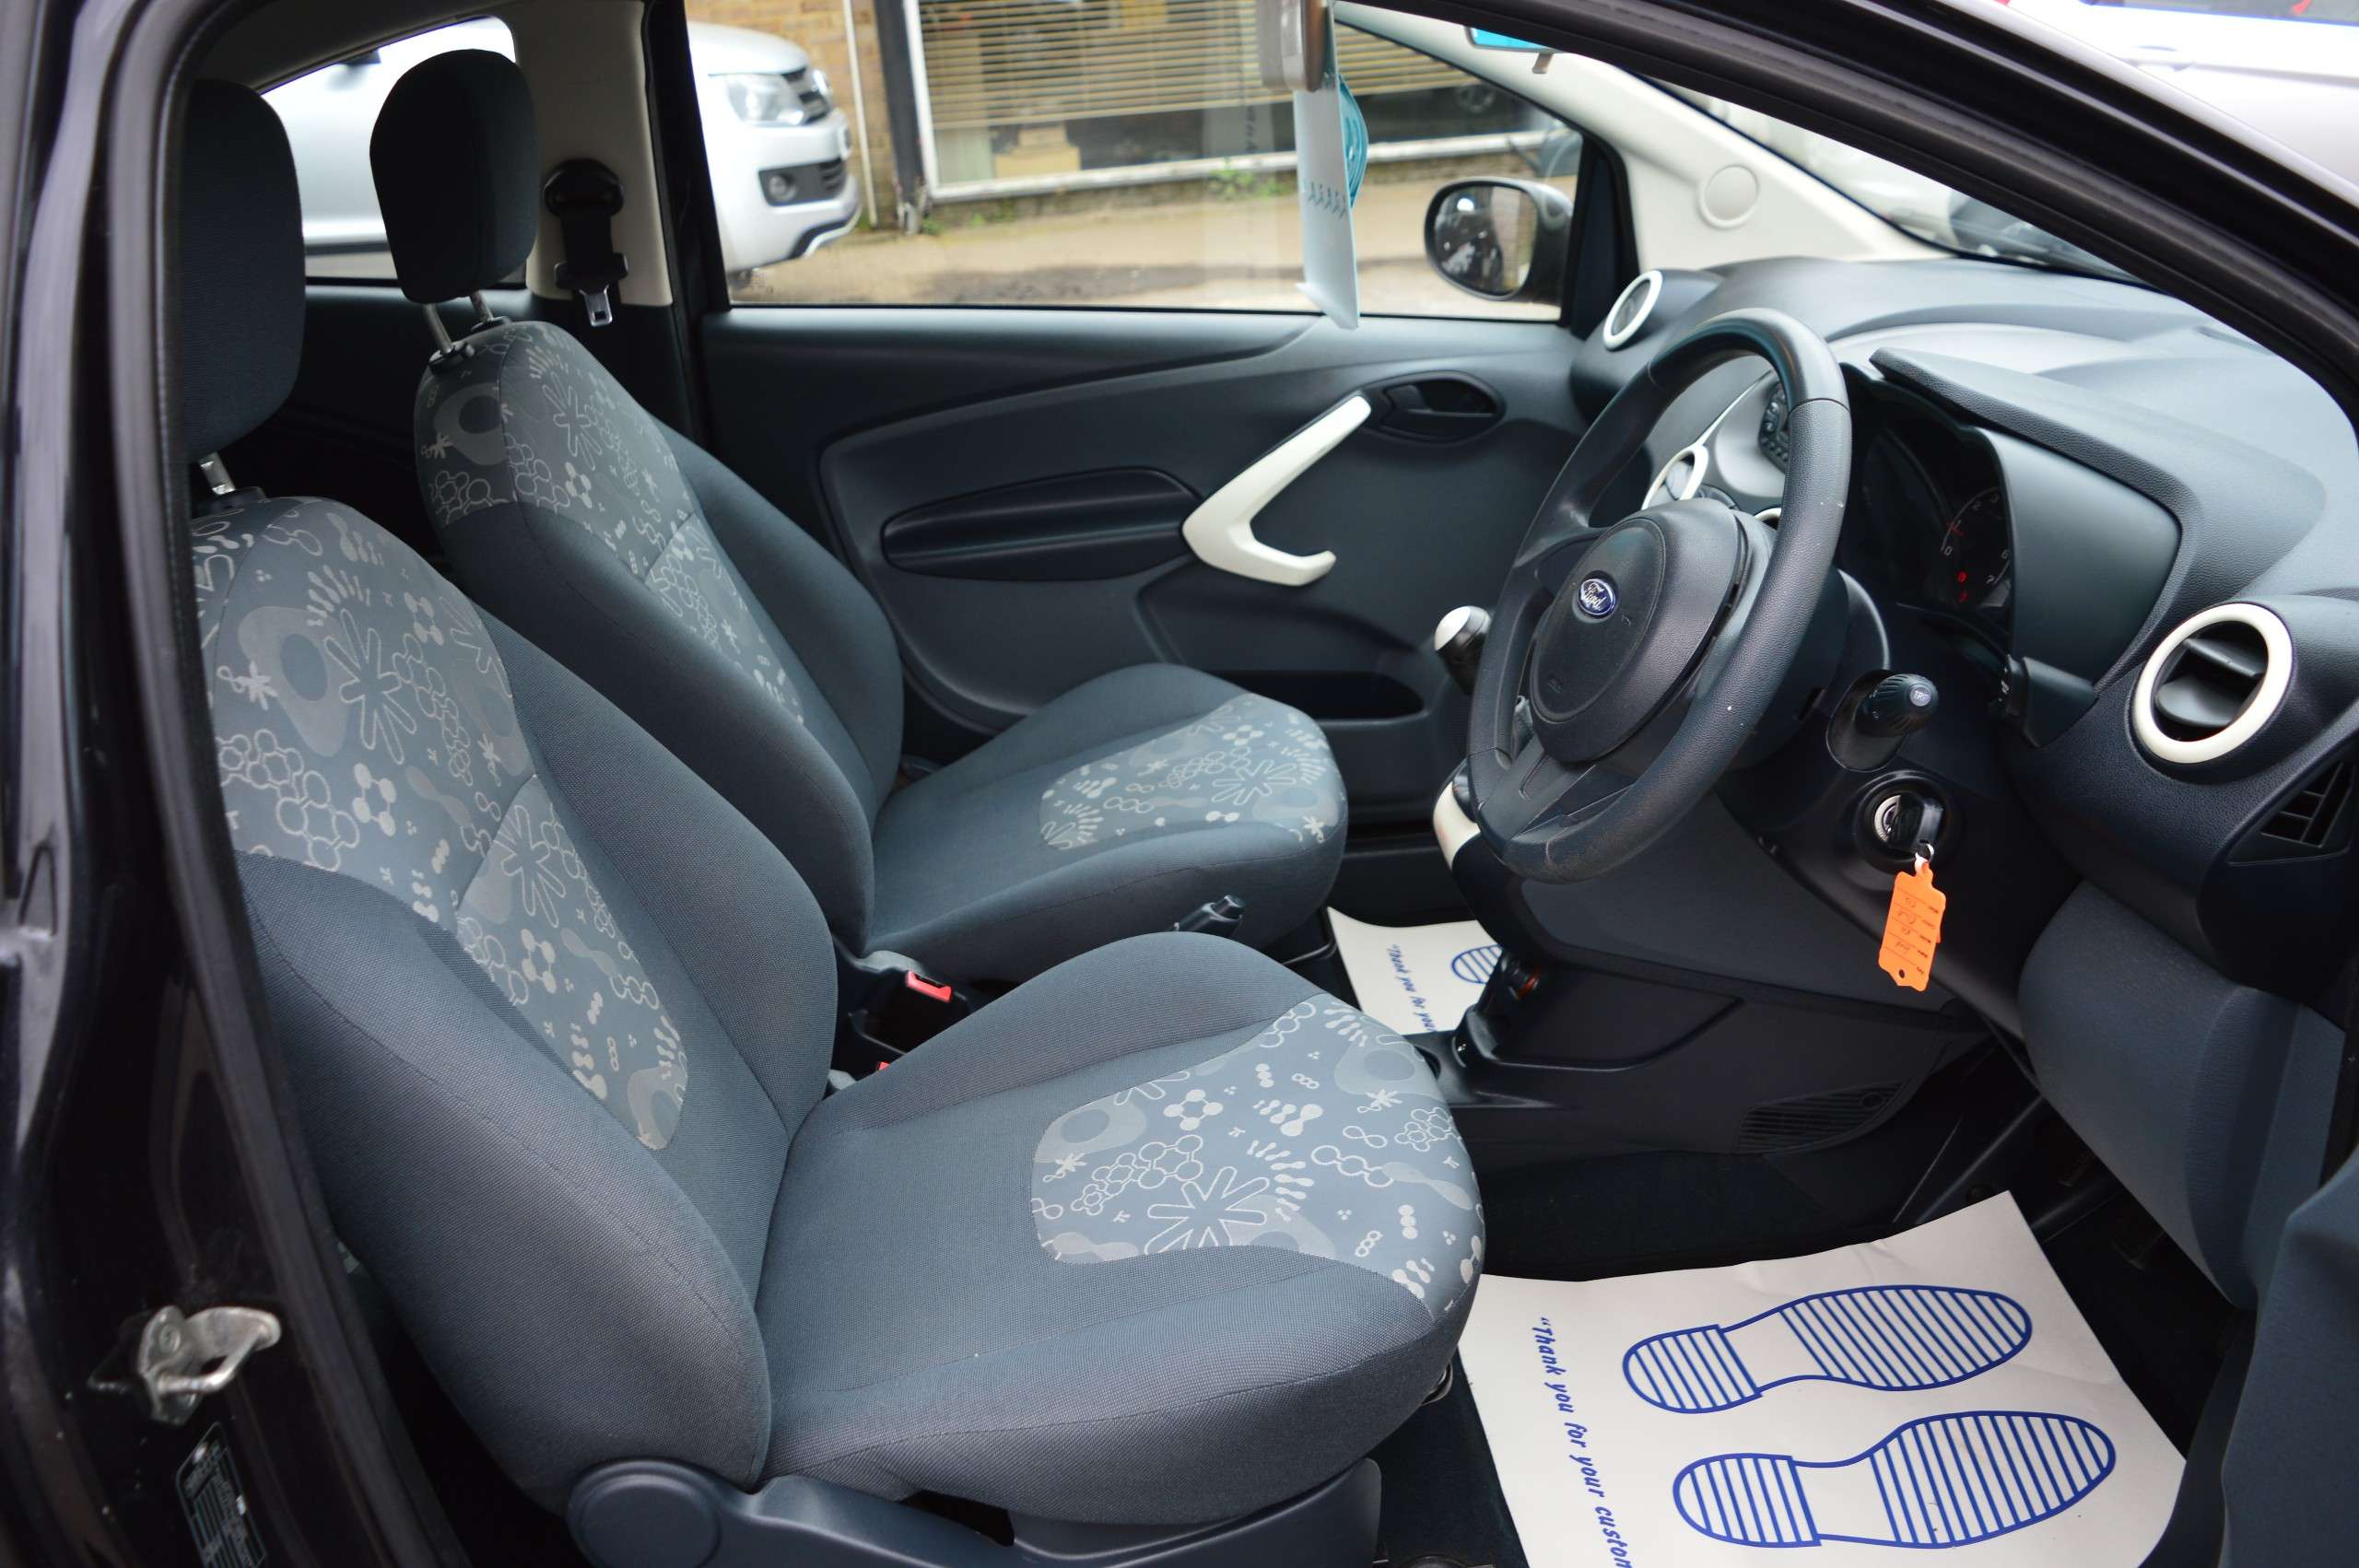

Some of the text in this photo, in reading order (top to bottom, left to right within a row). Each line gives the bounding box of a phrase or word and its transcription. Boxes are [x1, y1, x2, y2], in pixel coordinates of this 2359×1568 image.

[1582, 581, 1608, 611] Ford
[1543, 1381, 1575, 1413] you
[1564, 1422, 1588, 1448] for
[1568, 1454, 1605, 1498] your
